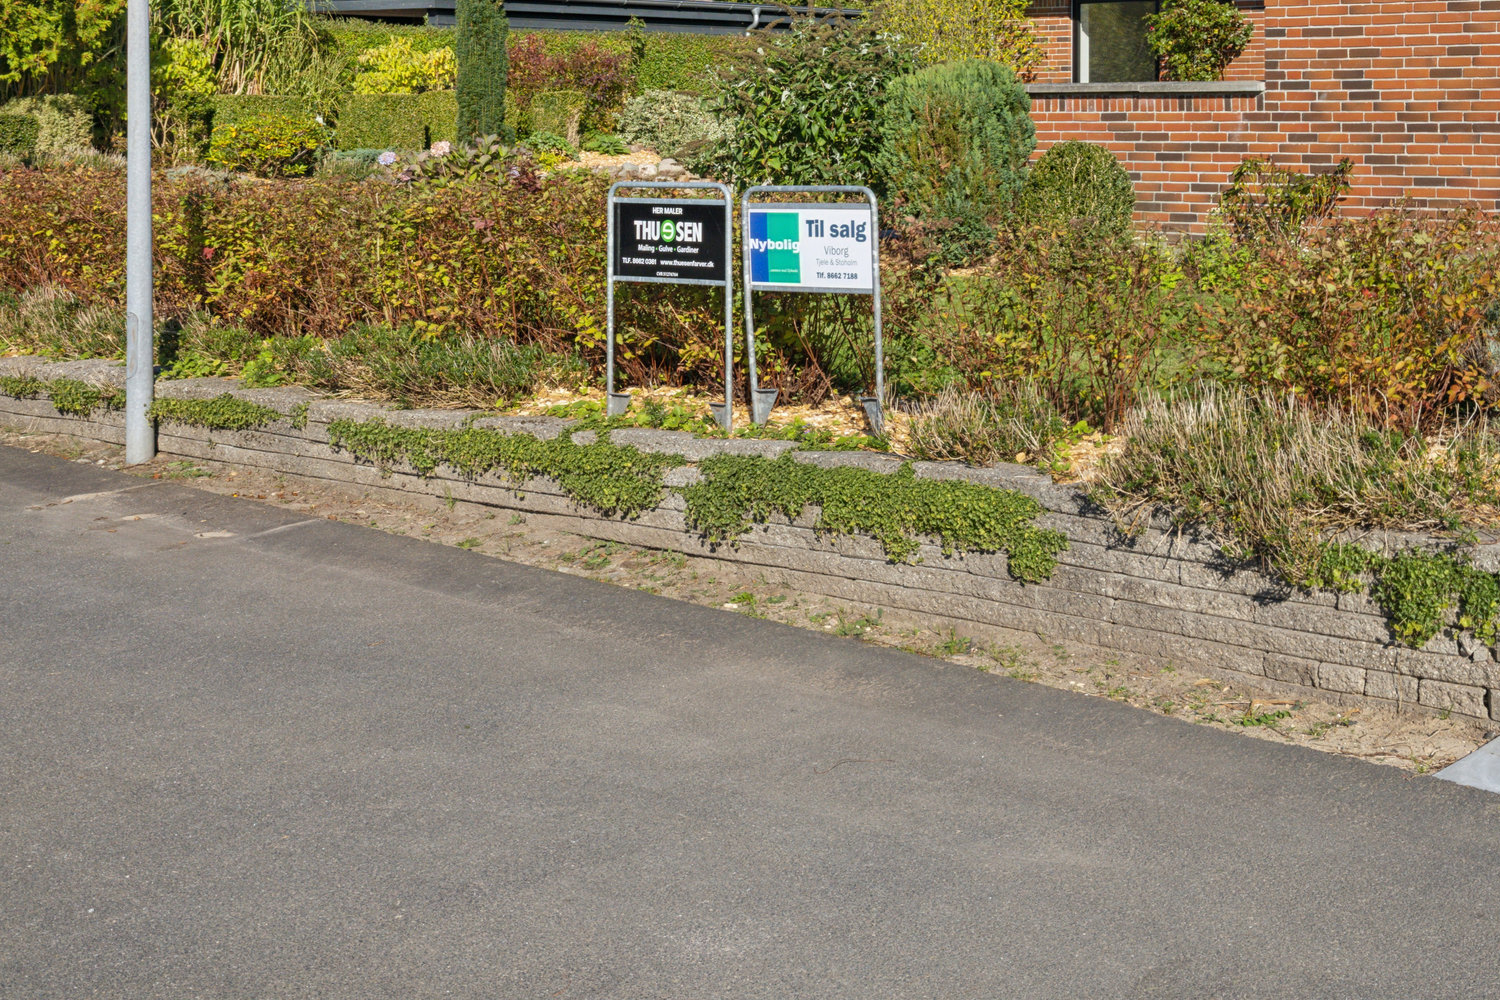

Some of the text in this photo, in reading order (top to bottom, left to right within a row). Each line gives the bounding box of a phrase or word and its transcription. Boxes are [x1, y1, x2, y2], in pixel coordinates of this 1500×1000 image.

[664, 207, 683, 215] MALER
[805, 219, 867, 242] Til salg
[638, 244, 699, 254] Maling Gulve Gardiner
[750, 238, 800, 253] Nybolig
[823, 245, 850, 258] Viborg
[829, 258, 835, 266] &
[816, 271, 858, 280] Tlf. 8662 7188
